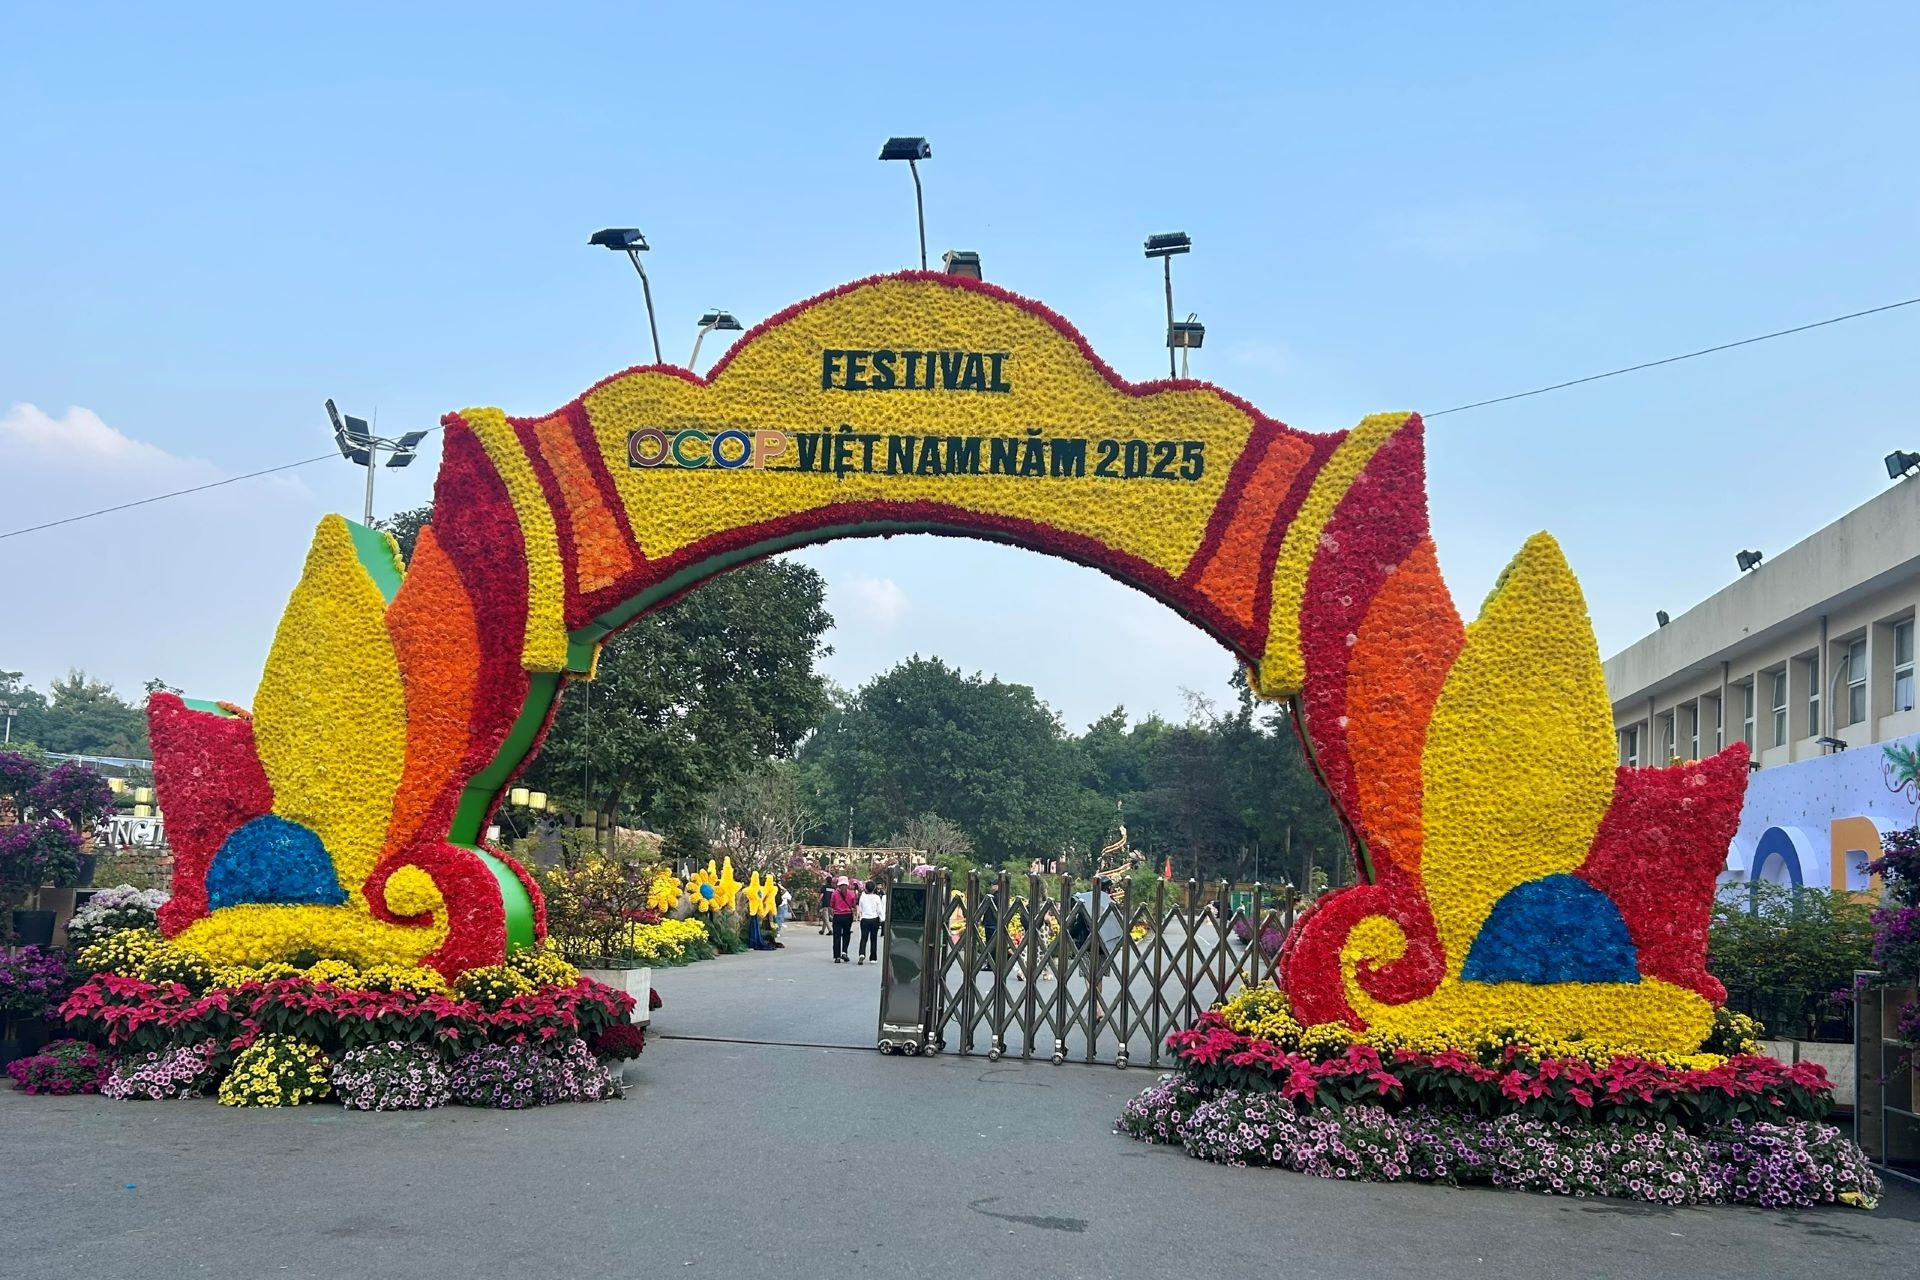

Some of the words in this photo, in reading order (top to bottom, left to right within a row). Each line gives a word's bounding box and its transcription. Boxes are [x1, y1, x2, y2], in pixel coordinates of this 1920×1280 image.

[822, 349, 1011, 393] FESTIVAL
[629, 428, 787, 470] OCOP
[887, 434, 981, 476] NAM
[990, 427, 1087, 478] NĂM
[1095, 439, 1205, 482] 2025
